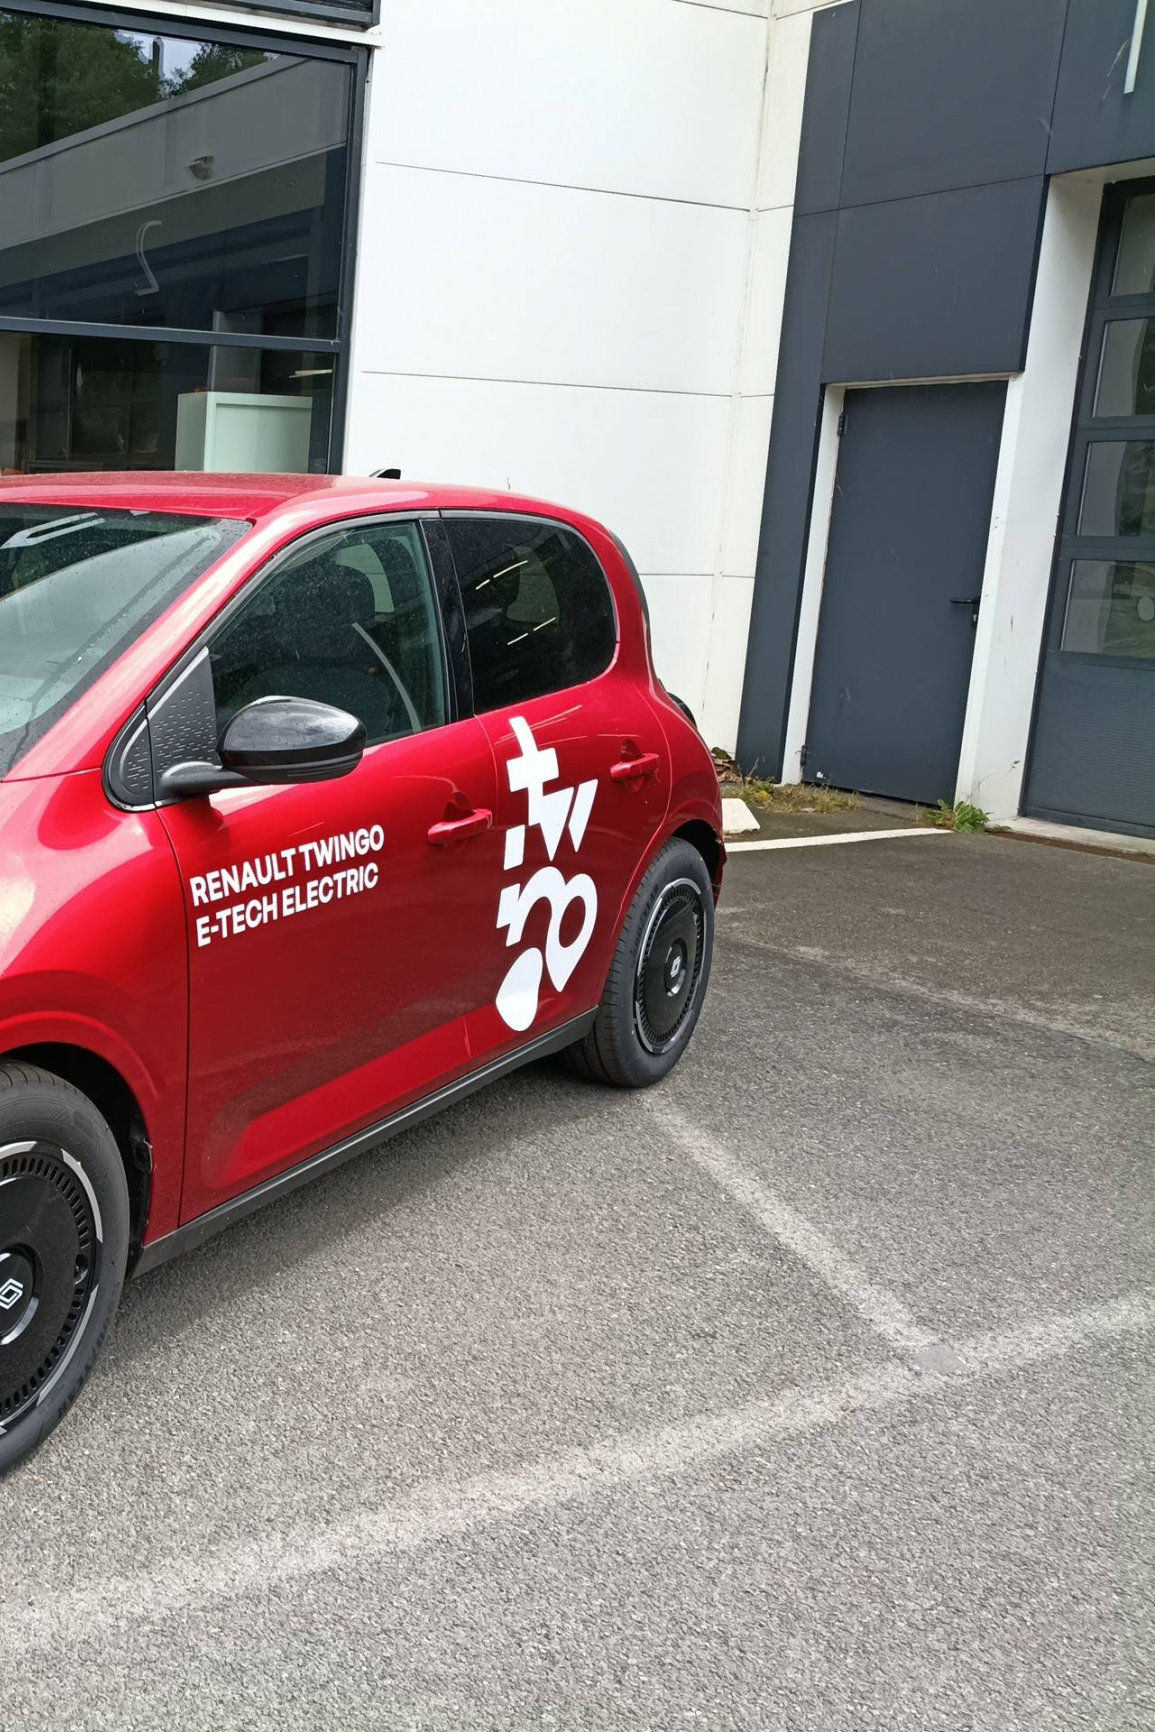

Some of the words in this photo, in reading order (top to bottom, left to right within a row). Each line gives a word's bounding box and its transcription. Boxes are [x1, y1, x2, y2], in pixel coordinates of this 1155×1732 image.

[189, 848, 296, 907] RENAULT
[299, 824, 385, 871] TWINGO
[196, 893, 278, 947] E-TECH
[282, 862, 379, 917] ELECTRIC
